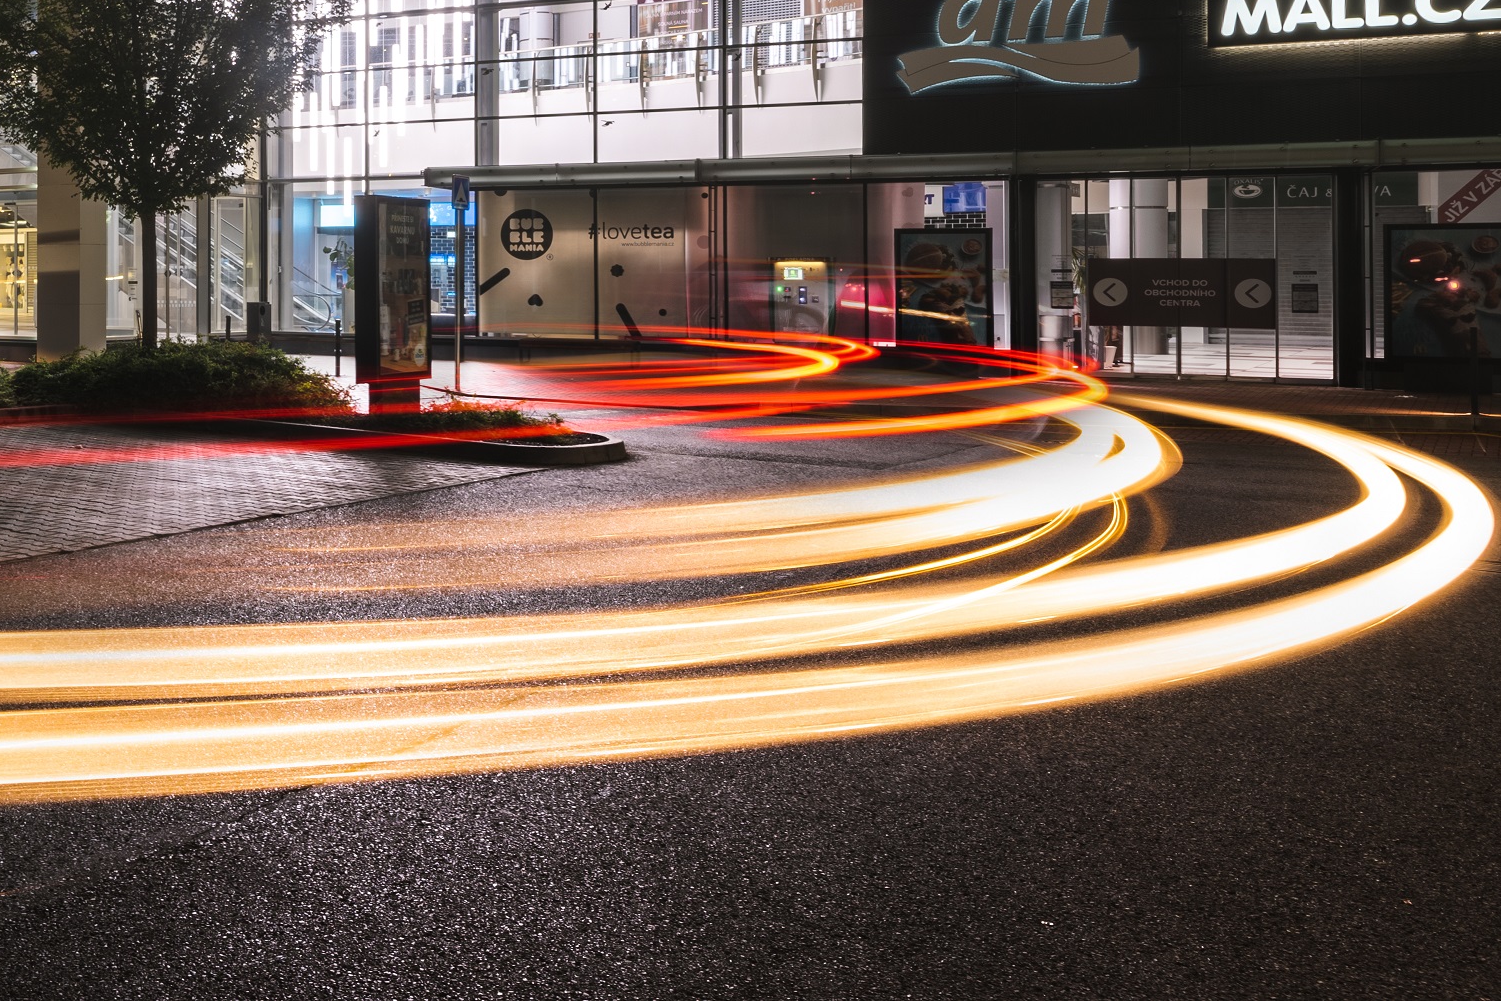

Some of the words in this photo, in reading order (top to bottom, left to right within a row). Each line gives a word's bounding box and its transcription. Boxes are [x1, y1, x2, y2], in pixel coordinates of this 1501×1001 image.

[1233, 178, 1261, 186] OXALIS
[1286, 184, 1318, 198] ČAJ
[1444, 199, 1470, 222] JIŽ
[1462, 190, 1478, 203] V
[588, 221, 675, 240] #lovetea
[509, 244, 544, 252] MANIA
[1152, 279, 1190, 287] VCHOD
[1192, 279, 1208, 287] DO
[1144, 288, 1216, 297] OBCHODNÍHO
[1159, 299, 1201, 307] CENTRA
